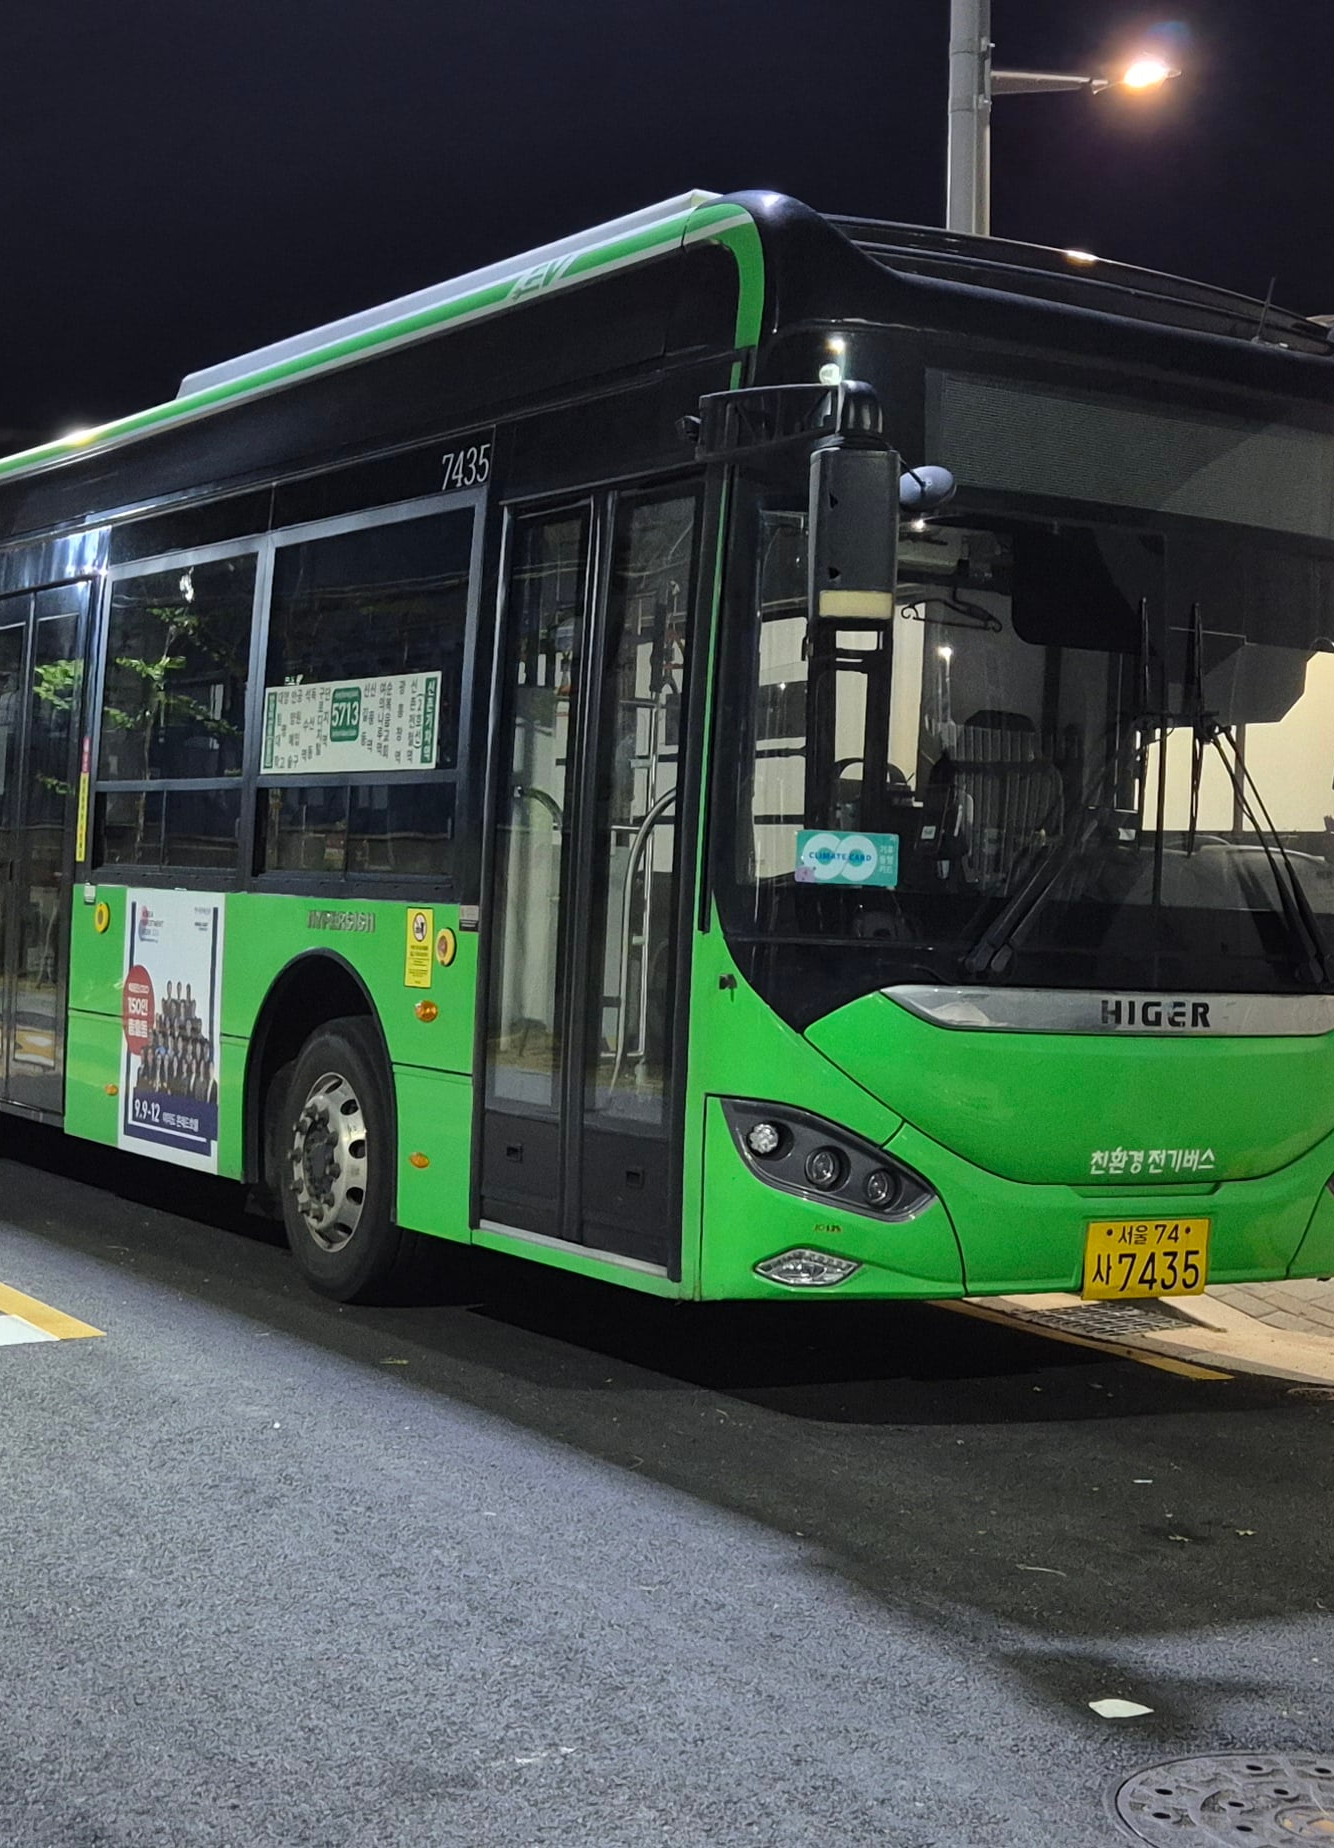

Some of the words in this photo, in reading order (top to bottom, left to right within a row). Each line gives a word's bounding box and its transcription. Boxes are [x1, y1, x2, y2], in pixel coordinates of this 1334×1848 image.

[441, 443, 491, 490] 7435
[331, 701, 360, 727] 5713
[809, 851, 846, 861] CLIMATE
[848, 853, 872, 862] CARD
[1101, 1000, 1210, 1028] HIGER
[134, 1098, 161, 1123] 9.9-12
[1090, 1146, 1144, 1175] 친환경
[1148, 1147, 1216, 1174] 전기버스
[1118, 1224, 1148, 1246] 서울
[1154, 1223, 1180, 1244] 74
